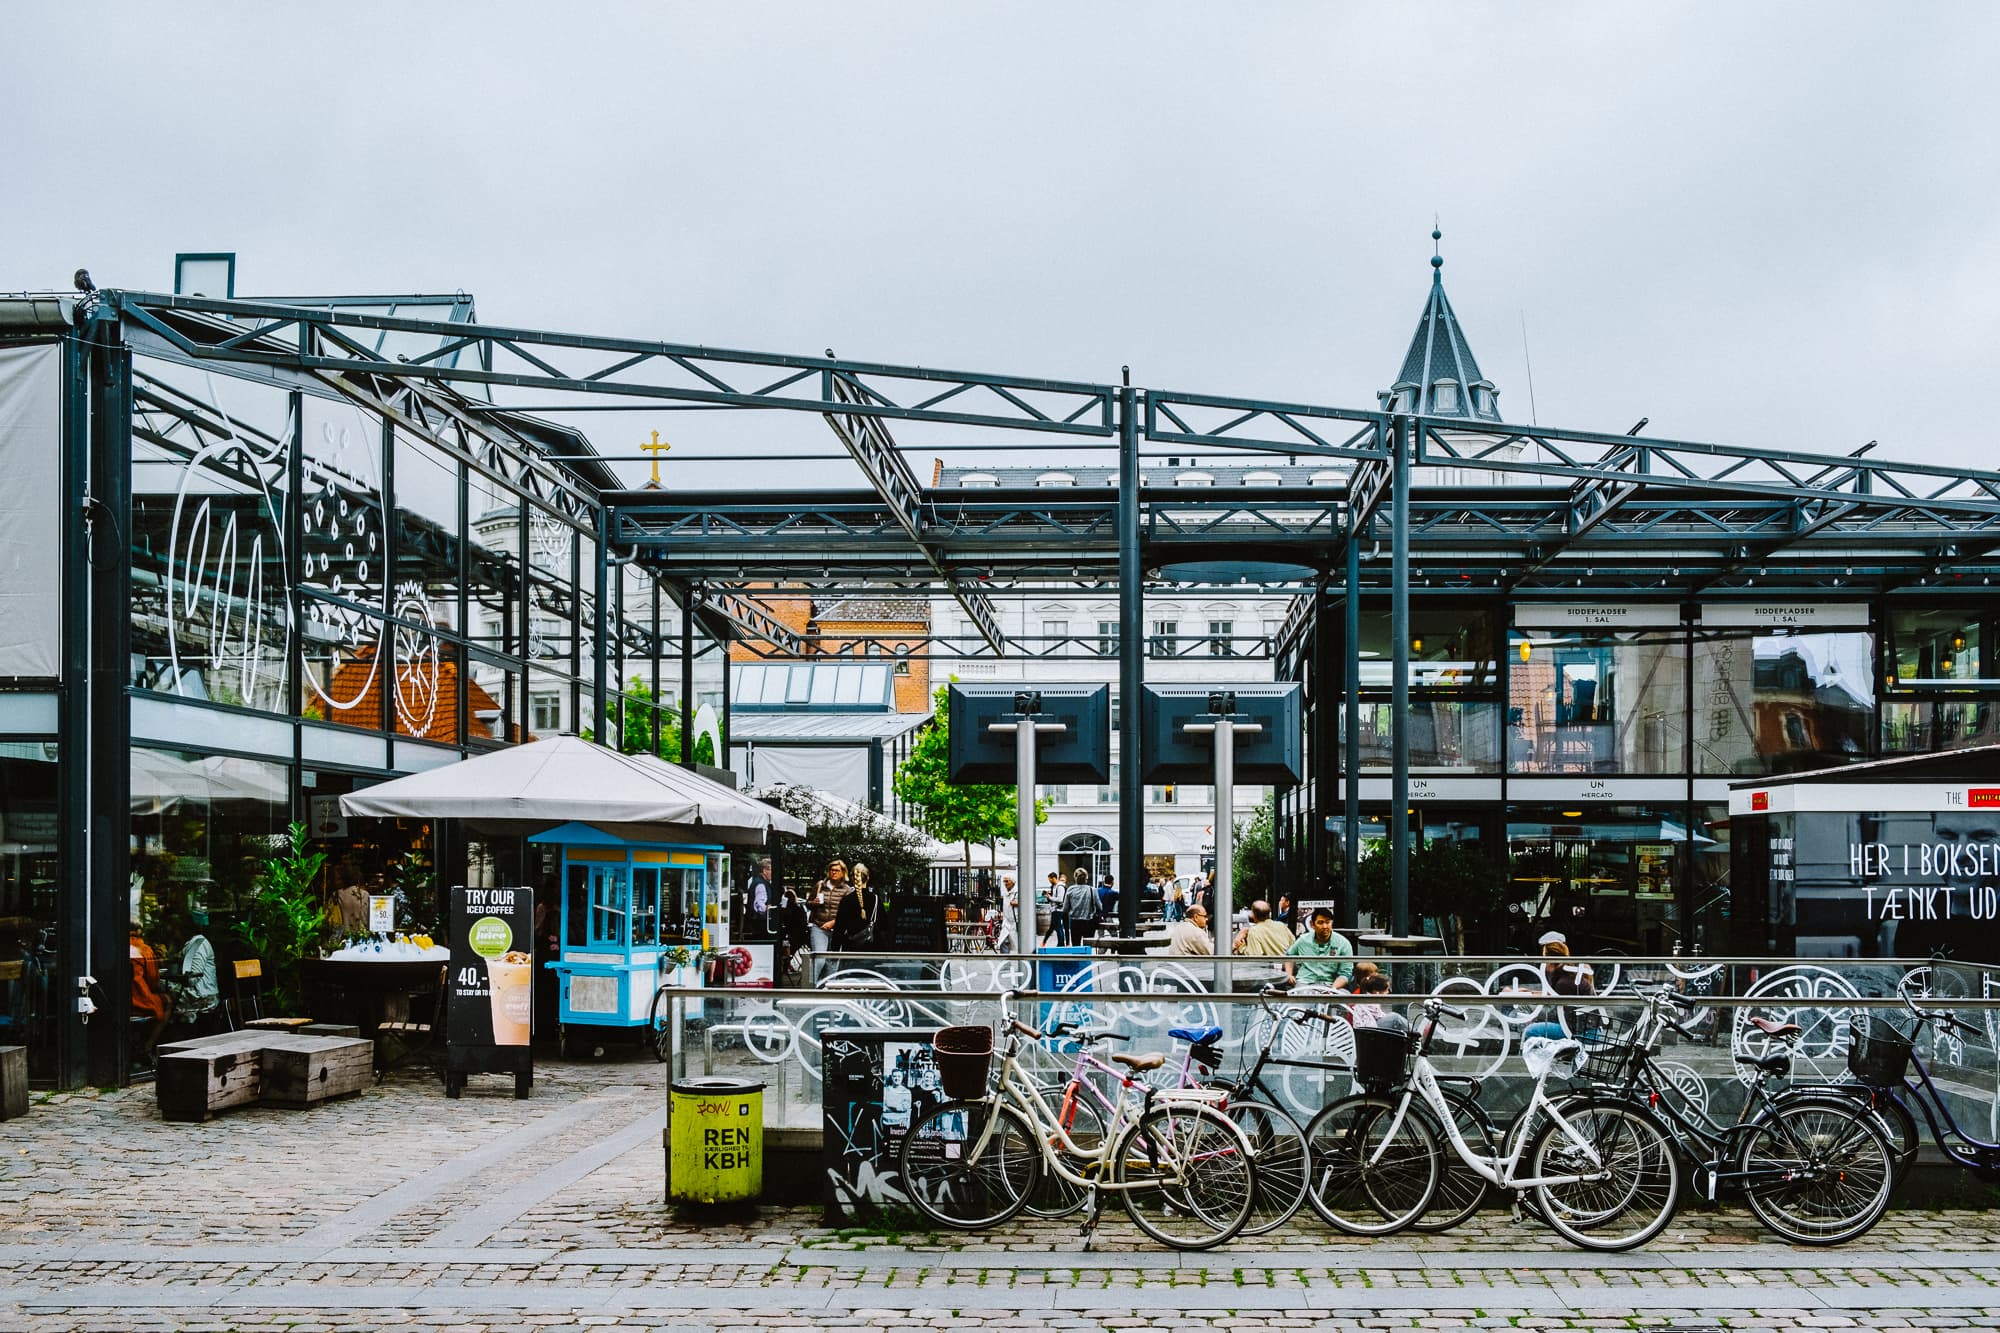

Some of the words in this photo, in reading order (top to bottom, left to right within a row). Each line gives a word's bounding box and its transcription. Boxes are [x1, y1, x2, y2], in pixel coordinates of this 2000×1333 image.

[1413, 780, 1427, 788] UN
[1590, 780, 1604, 789] UN
[1945, 791, 1963, 805] THE
[1850, 843, 1892, 876] HER
[1904, 844, 1909, 876] I
[465, 889, 488, 905] TRY
[490, 890, 514, 905] OUR
[1861, 887, 1956, 920] TÆNKT
[1969, 887, 1997, 920] UD
[466, 905, 484, 914] ICED
[486, 906, 514, 914] COFFEE
[458, 967, 488, 988] 40,-
[704, 1126, 749, 1146] REN
[704, 1151, 749, 1170] KBH
